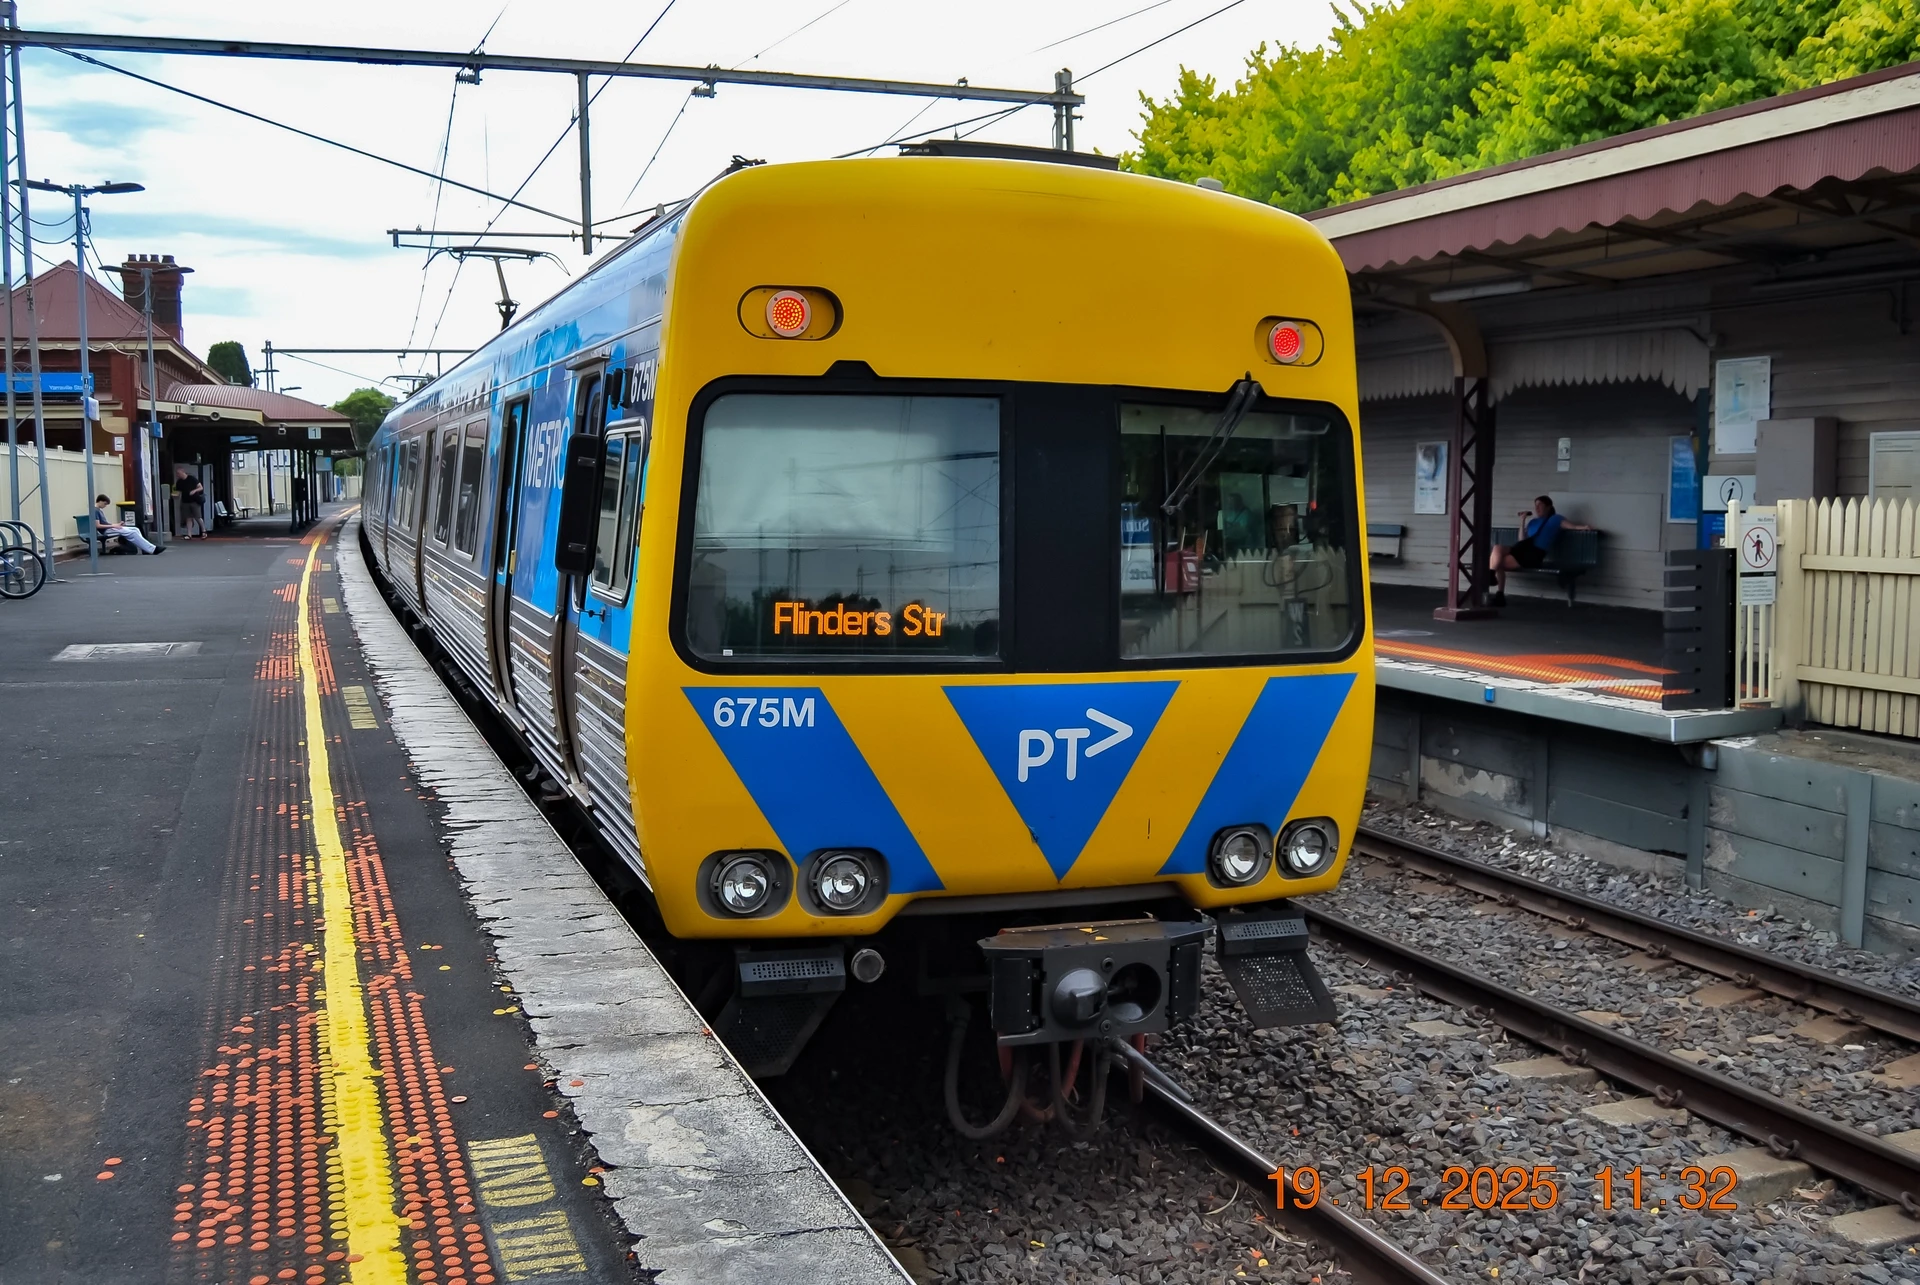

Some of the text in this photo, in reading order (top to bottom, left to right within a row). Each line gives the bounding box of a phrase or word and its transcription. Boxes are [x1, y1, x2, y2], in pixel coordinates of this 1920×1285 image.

[524, 417, 570, 489] METRO
[774, 602, 946, 637] Flinders Str
[713, 697, 815, 728] 675M
